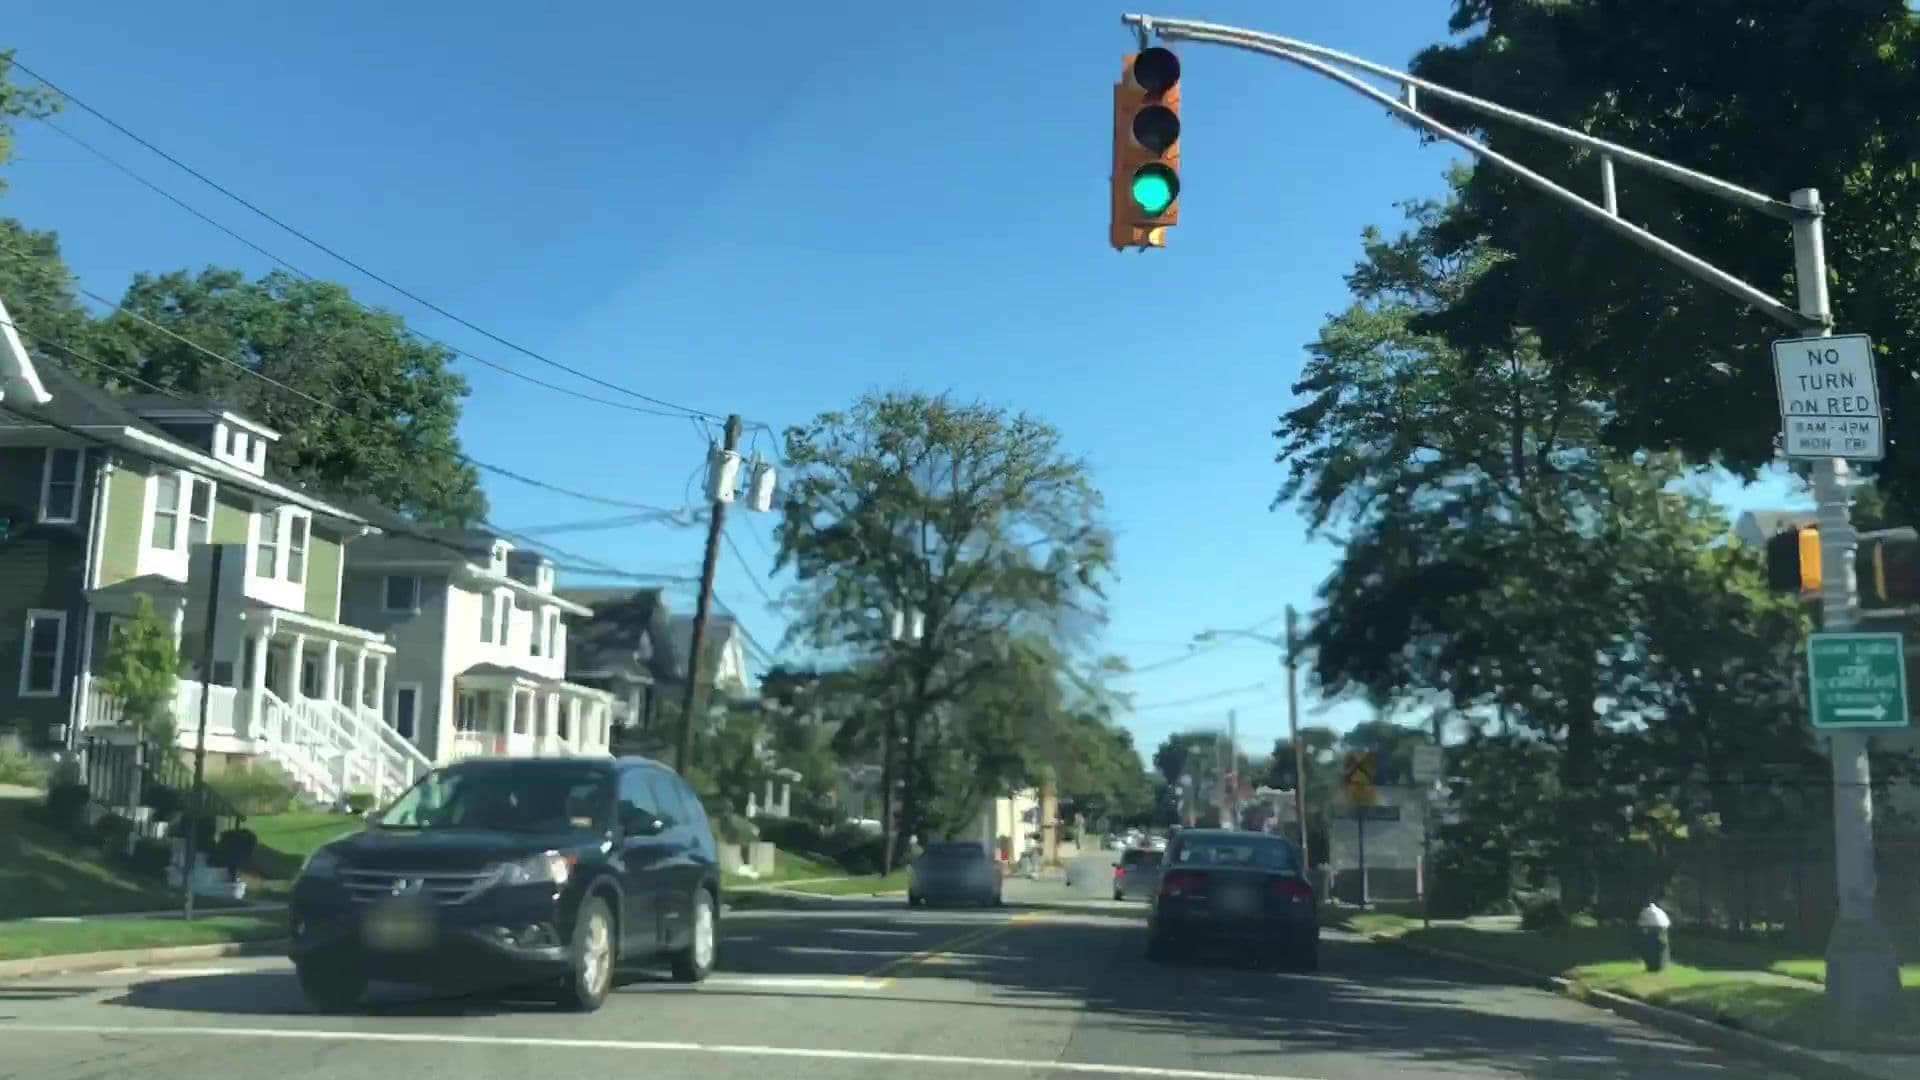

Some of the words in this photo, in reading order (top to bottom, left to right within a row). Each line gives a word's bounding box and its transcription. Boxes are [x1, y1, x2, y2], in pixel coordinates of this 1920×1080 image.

[1806, 348, 1839, 366] NO
[1798, 373, 1855, 392] TURN
[1790, 398, 1818, 413] ON
[1827, 396, 1869, 414] RED
